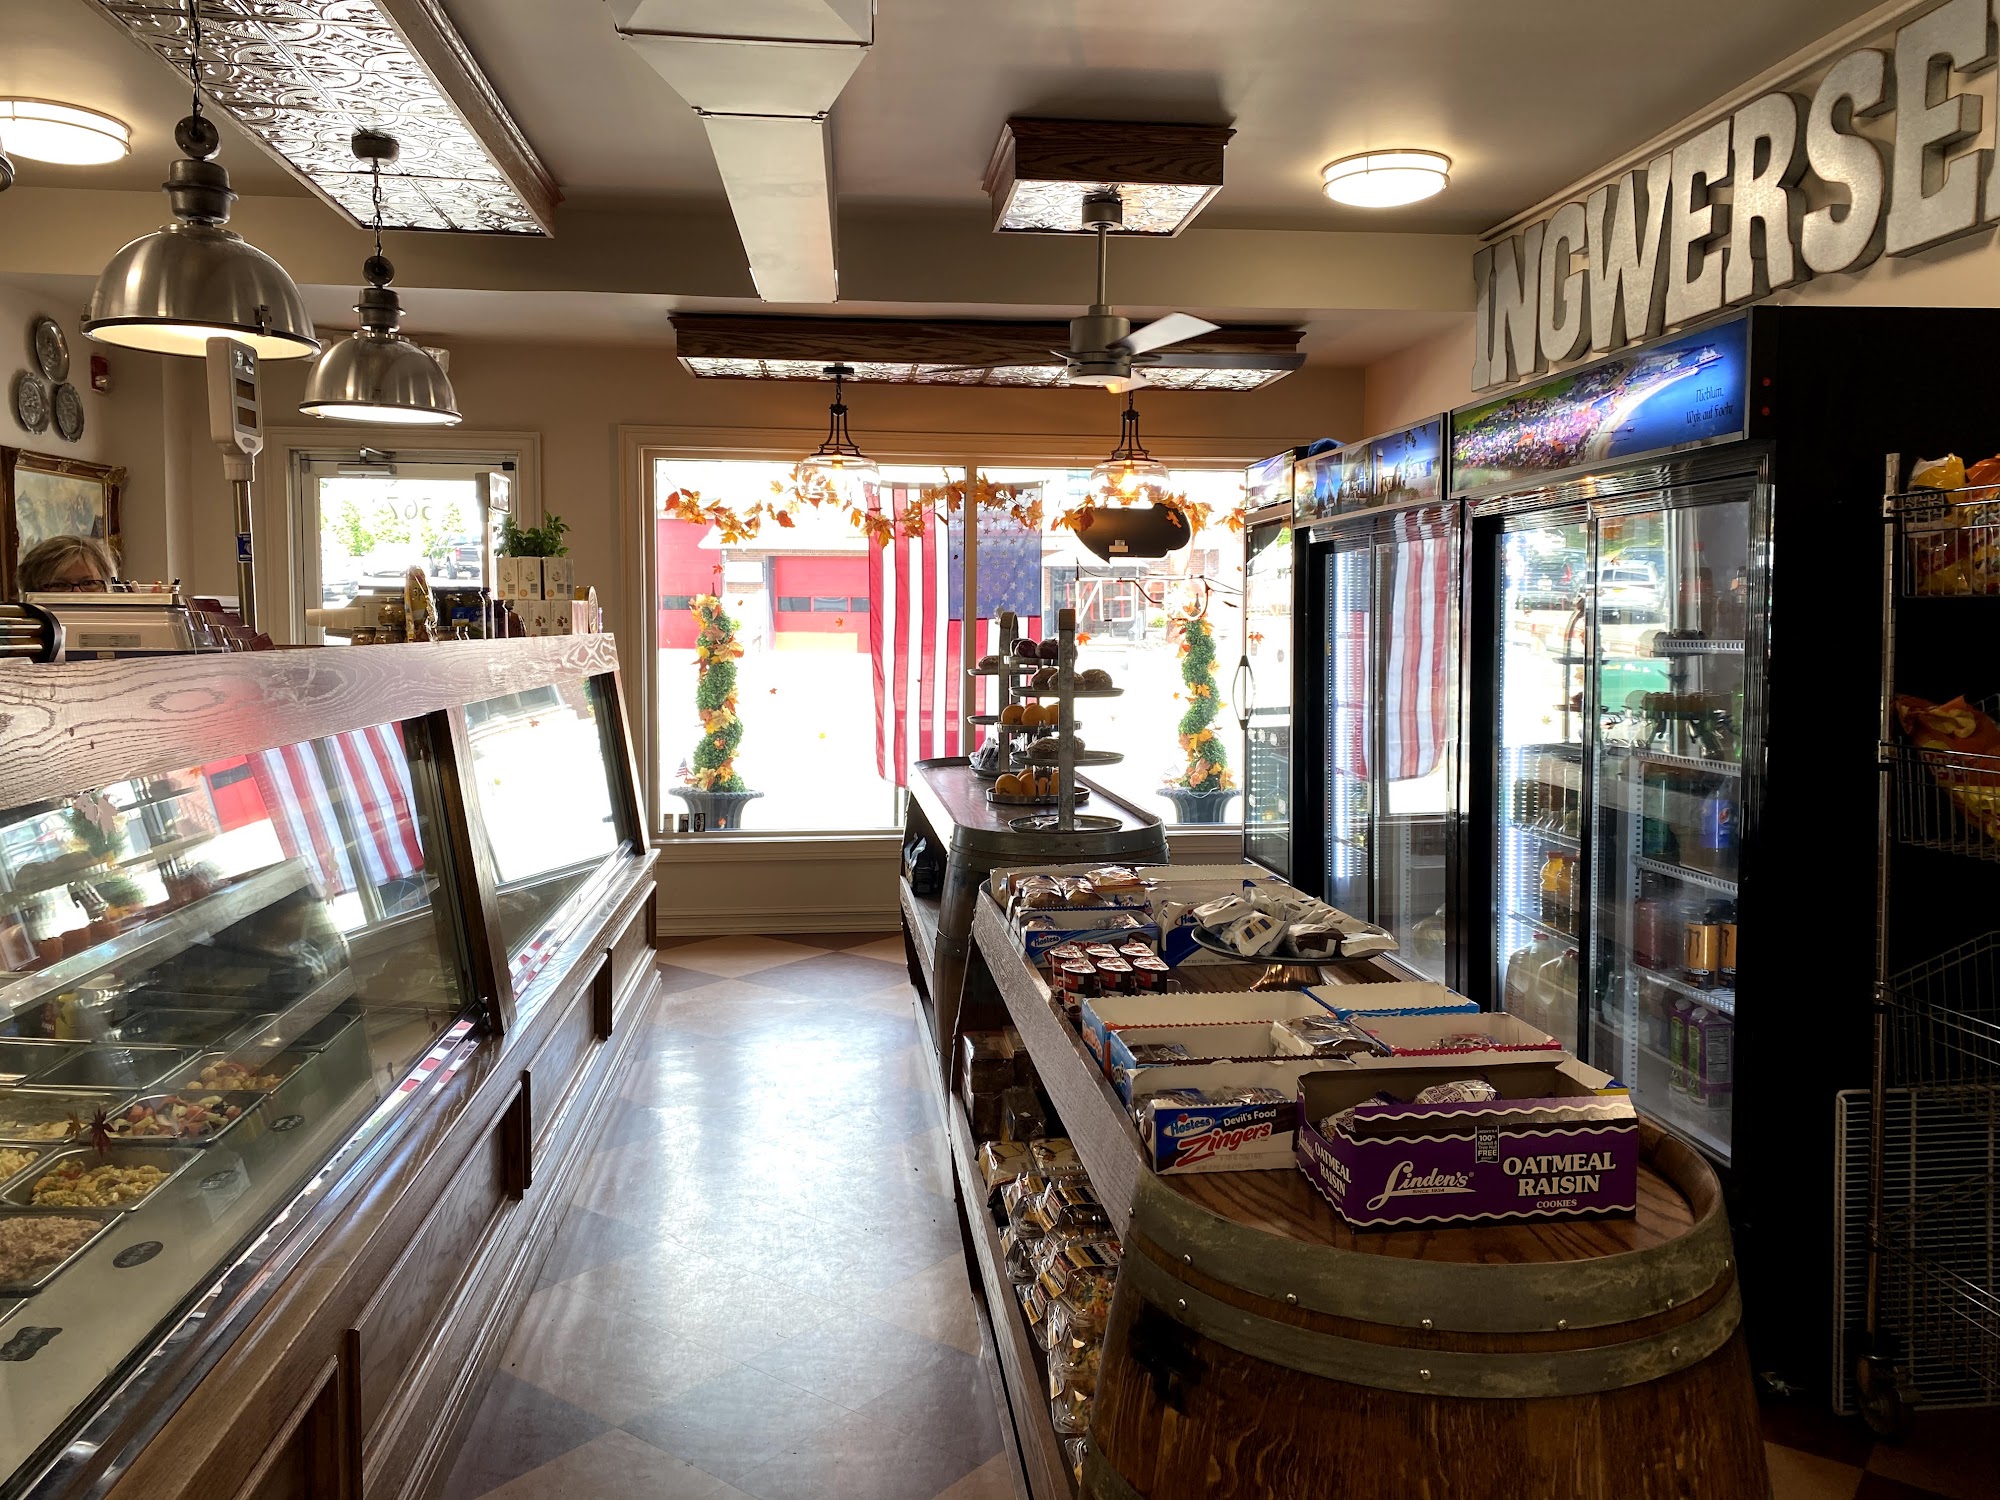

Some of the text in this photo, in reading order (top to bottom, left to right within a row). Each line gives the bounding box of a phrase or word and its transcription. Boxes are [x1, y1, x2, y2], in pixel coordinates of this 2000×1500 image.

[1472, 0, 2000, 392] INGWERSE
[1034, 936, 1060, 948] Hostess
[1171, 1109, 1277, 1136] Hostess Devil's Food
[1175, 1122, 1272, 1168] Zingers
[1314, 1141, 1352, 1183] OATMEAL
[1502, 1152, 1617, 1176] OATMEAL
[1320, 1161, 1346, 1197] RAISIN
[1366, 1160, 1470, 1211] Linden's
[1518, 1174, 1601, 1197] RAISIN
[1536, 1199, 1578, 1209] COOKIES
